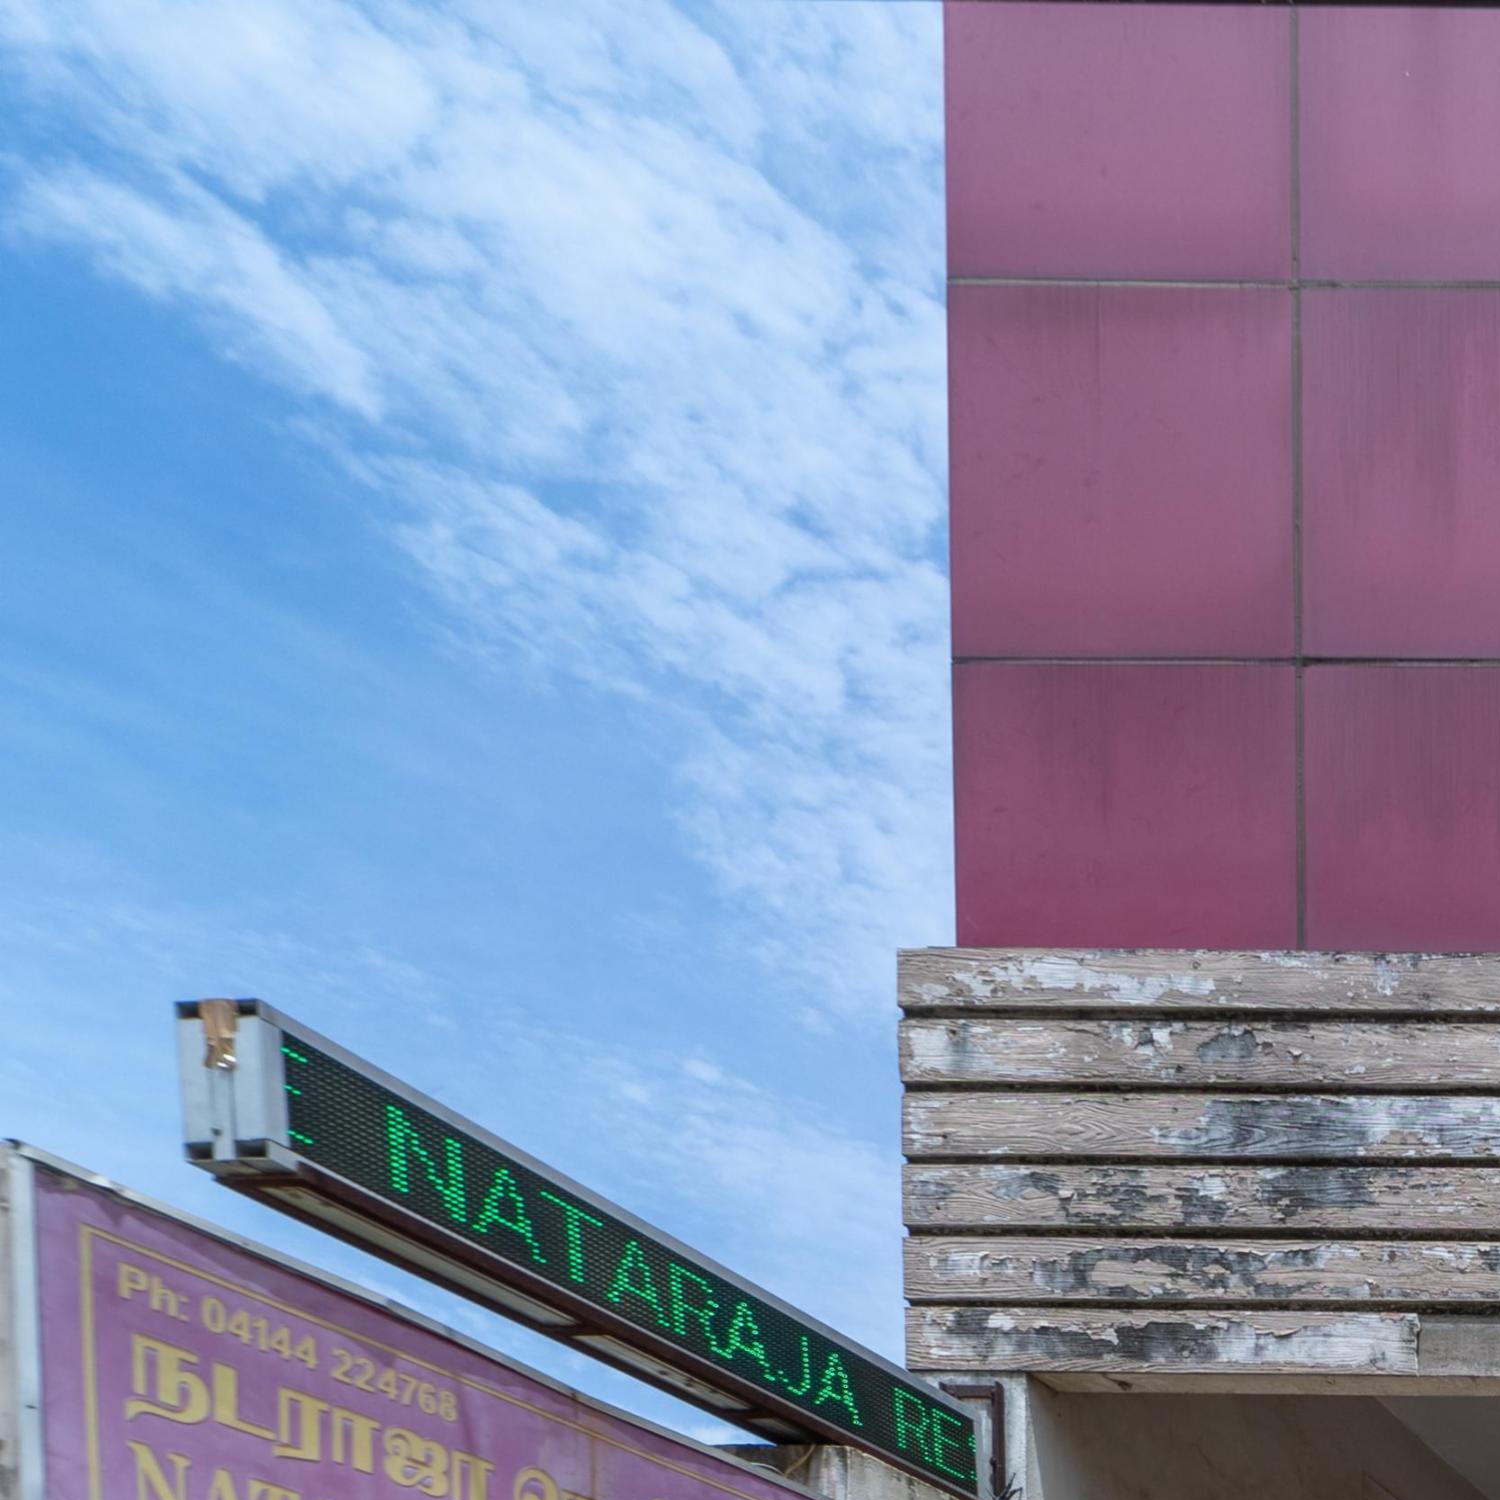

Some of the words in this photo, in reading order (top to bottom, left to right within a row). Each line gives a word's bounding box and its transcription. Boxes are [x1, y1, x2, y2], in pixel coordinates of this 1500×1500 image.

[117, 1262, 190, 1322] Ph:
[202, 1296, 318, 1370] 04144
[330, 1346, 458, 1422] 224768
[386, 1105, 863, 1427] NATARAJA
[894, 1387, 977, 1480] RE
